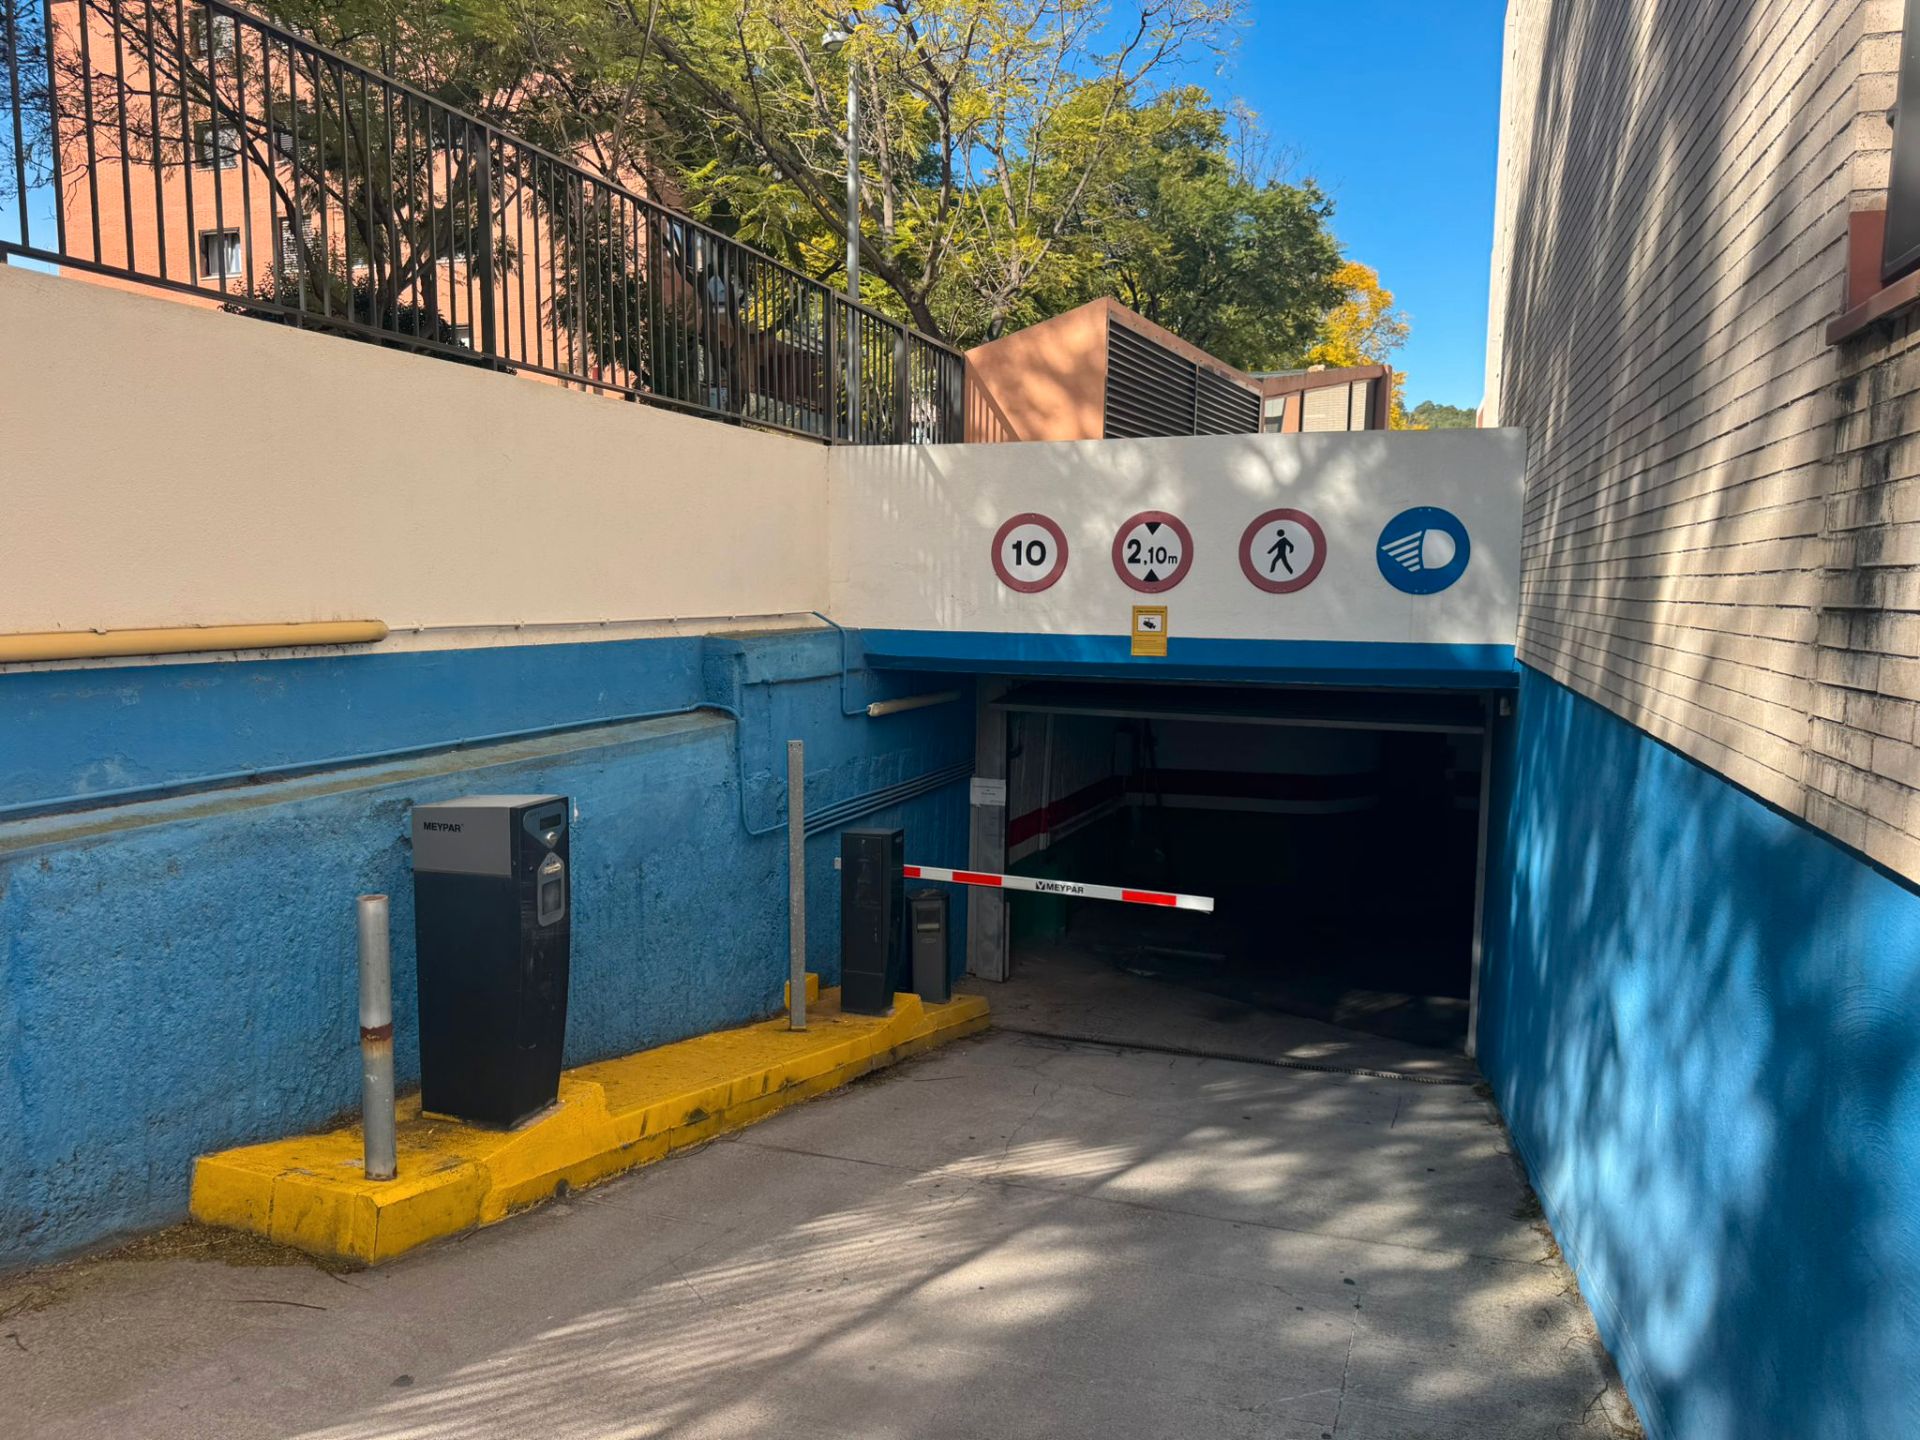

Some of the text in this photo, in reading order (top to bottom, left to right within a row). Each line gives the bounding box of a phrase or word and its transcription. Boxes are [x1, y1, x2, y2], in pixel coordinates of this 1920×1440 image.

[1012, 540, 1047, 567] 10
[423, 821, 462, 833] MEYPAR
[1046, 882, 1084, 894] MEYPAR
